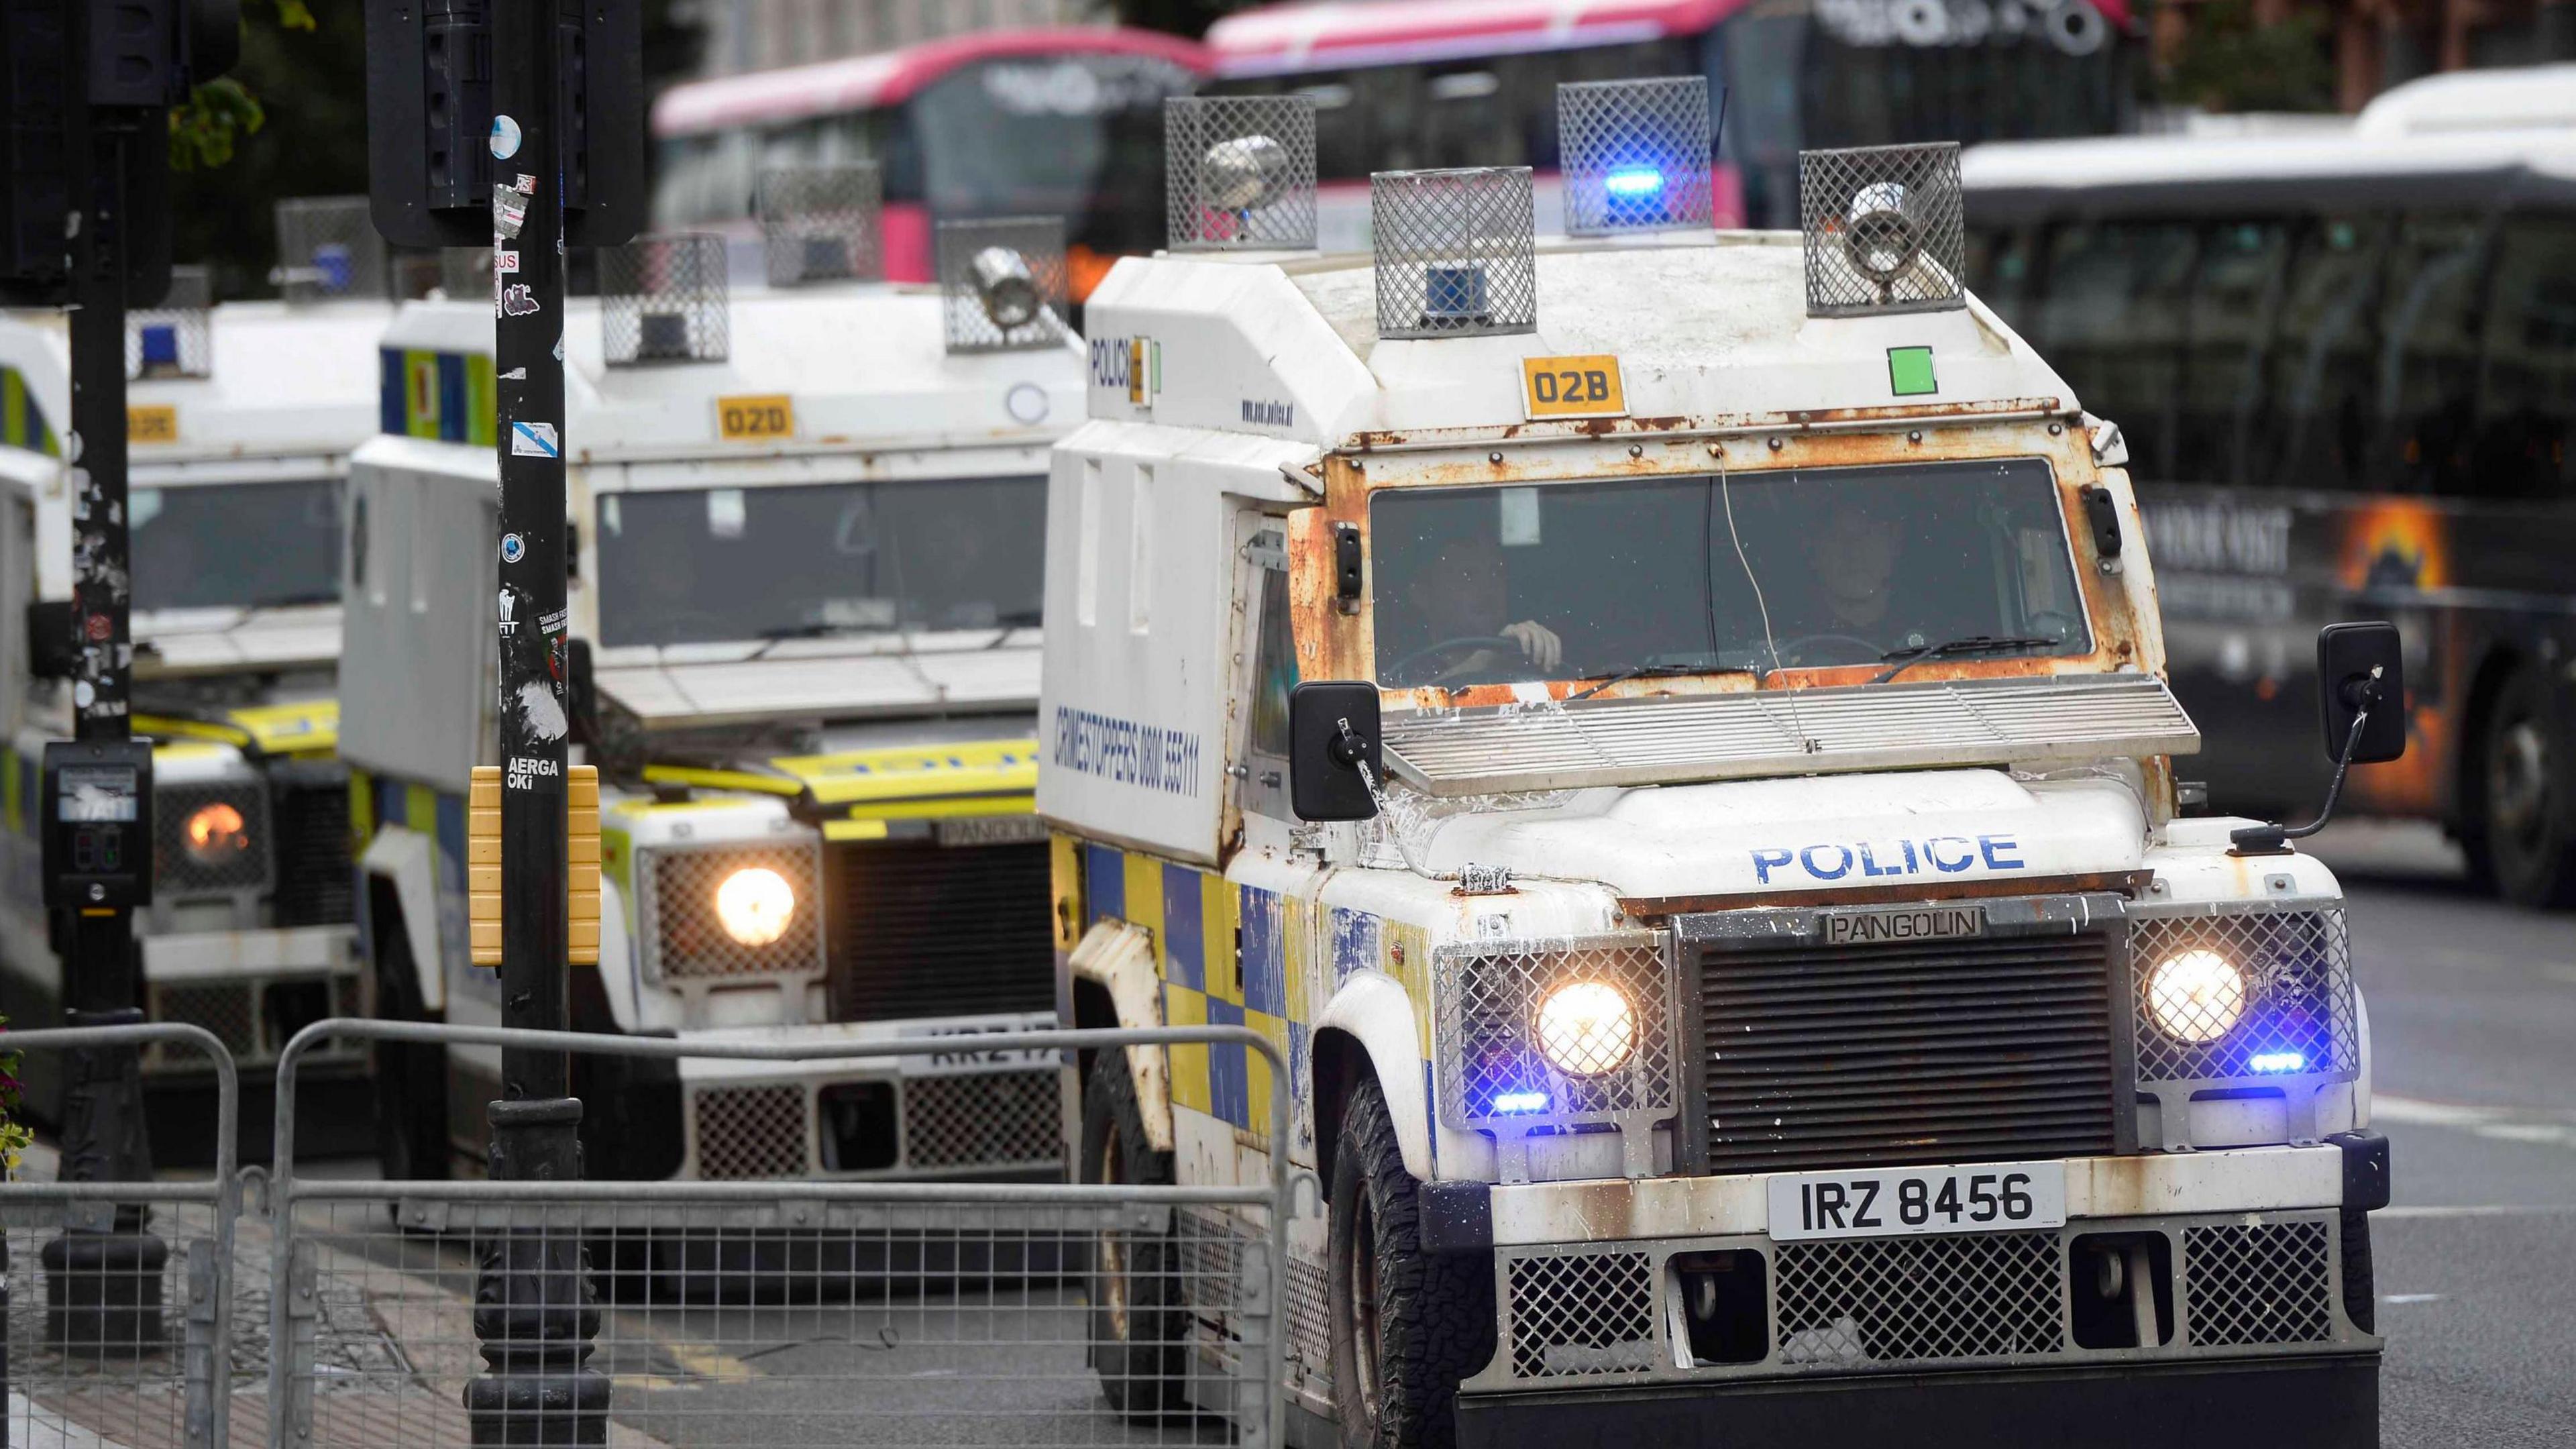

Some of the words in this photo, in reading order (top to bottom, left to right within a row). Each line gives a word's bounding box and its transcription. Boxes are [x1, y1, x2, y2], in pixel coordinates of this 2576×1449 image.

[1534, 370, 1609, 402] 02B
[727, 407, 787, 435] 02D
[539, 611, 559, 625] SMASH
[1055, 705, 1138, 785] CRIMESTOPPERS
[1140, 724, 1163, 791] 0800
[508, 757, 559, 776] AERGA
[1749, 834, 2025, 885] POLICE
[1831, 910, 1977, 943] PANGOLIN
[1801, 1179, 1882, 1230] IRZ
[1898, 1173, 2033, 1225] 8456
